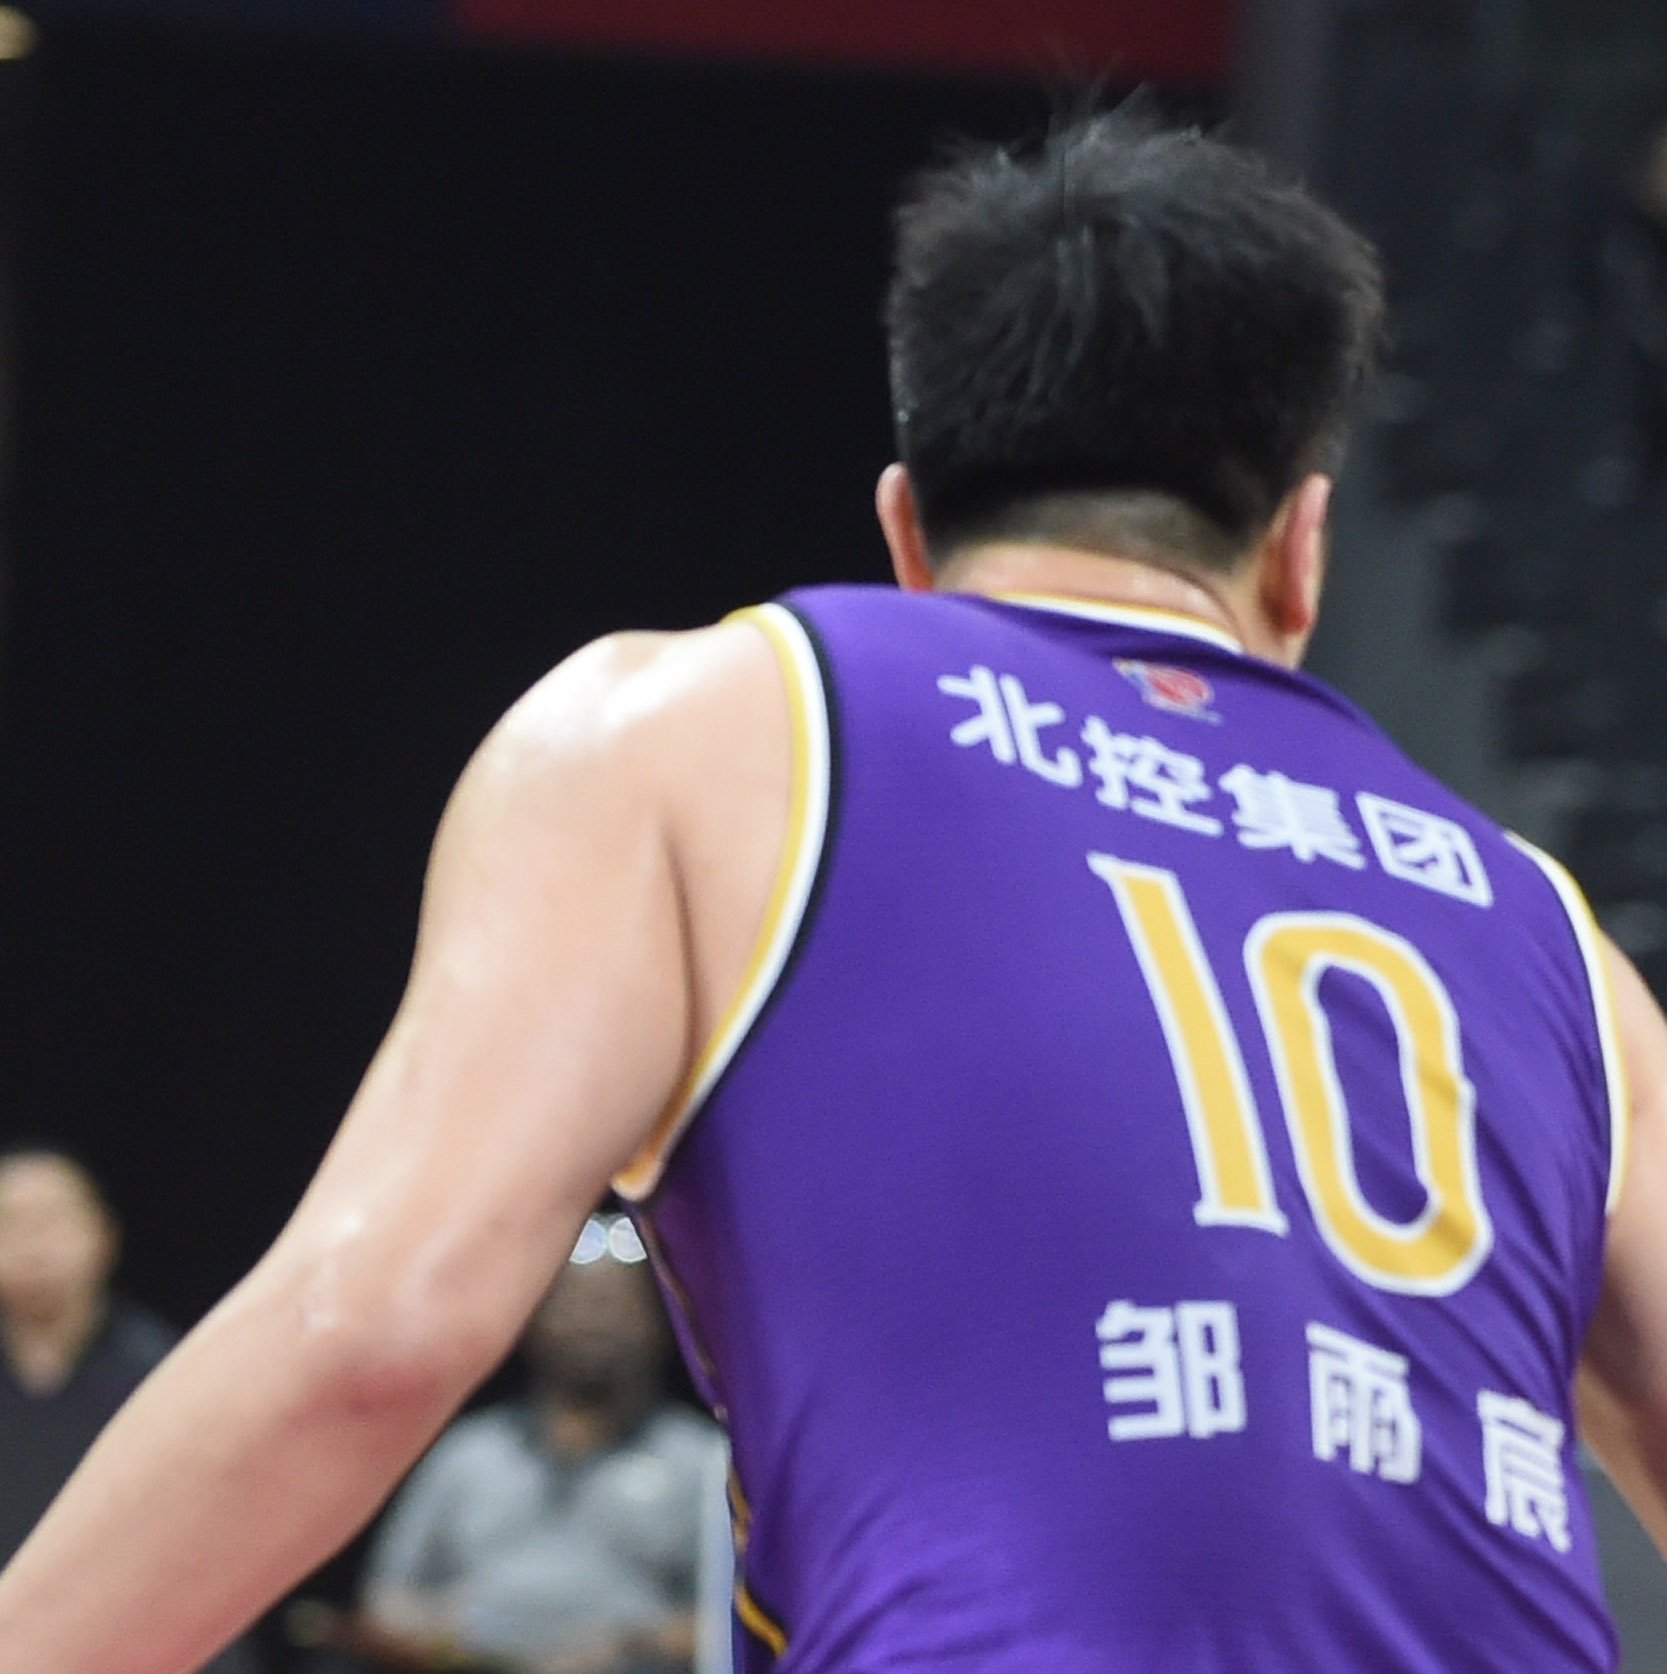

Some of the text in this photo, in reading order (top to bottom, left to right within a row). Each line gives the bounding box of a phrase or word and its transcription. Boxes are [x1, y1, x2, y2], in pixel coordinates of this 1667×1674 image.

[938, 666, 1494, 907] 北控集团
[1087, 851, 1494, 1298] 10
